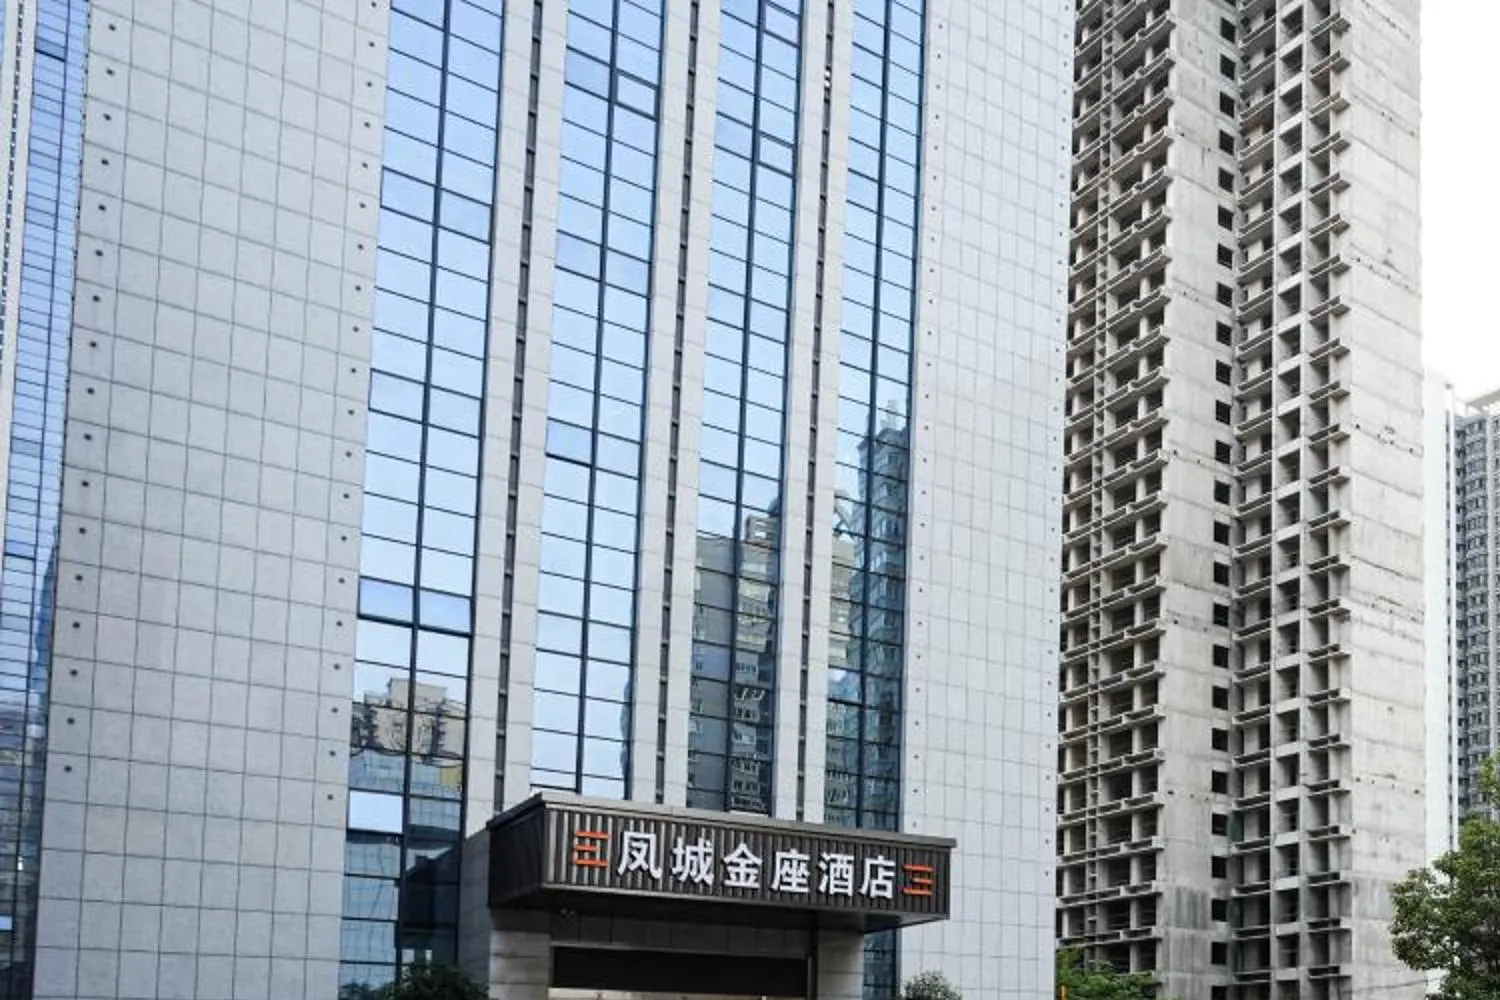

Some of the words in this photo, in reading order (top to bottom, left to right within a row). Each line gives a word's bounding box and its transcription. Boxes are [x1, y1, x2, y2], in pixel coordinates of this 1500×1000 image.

[617, 831, 896, 900] 凤城金座酒店
